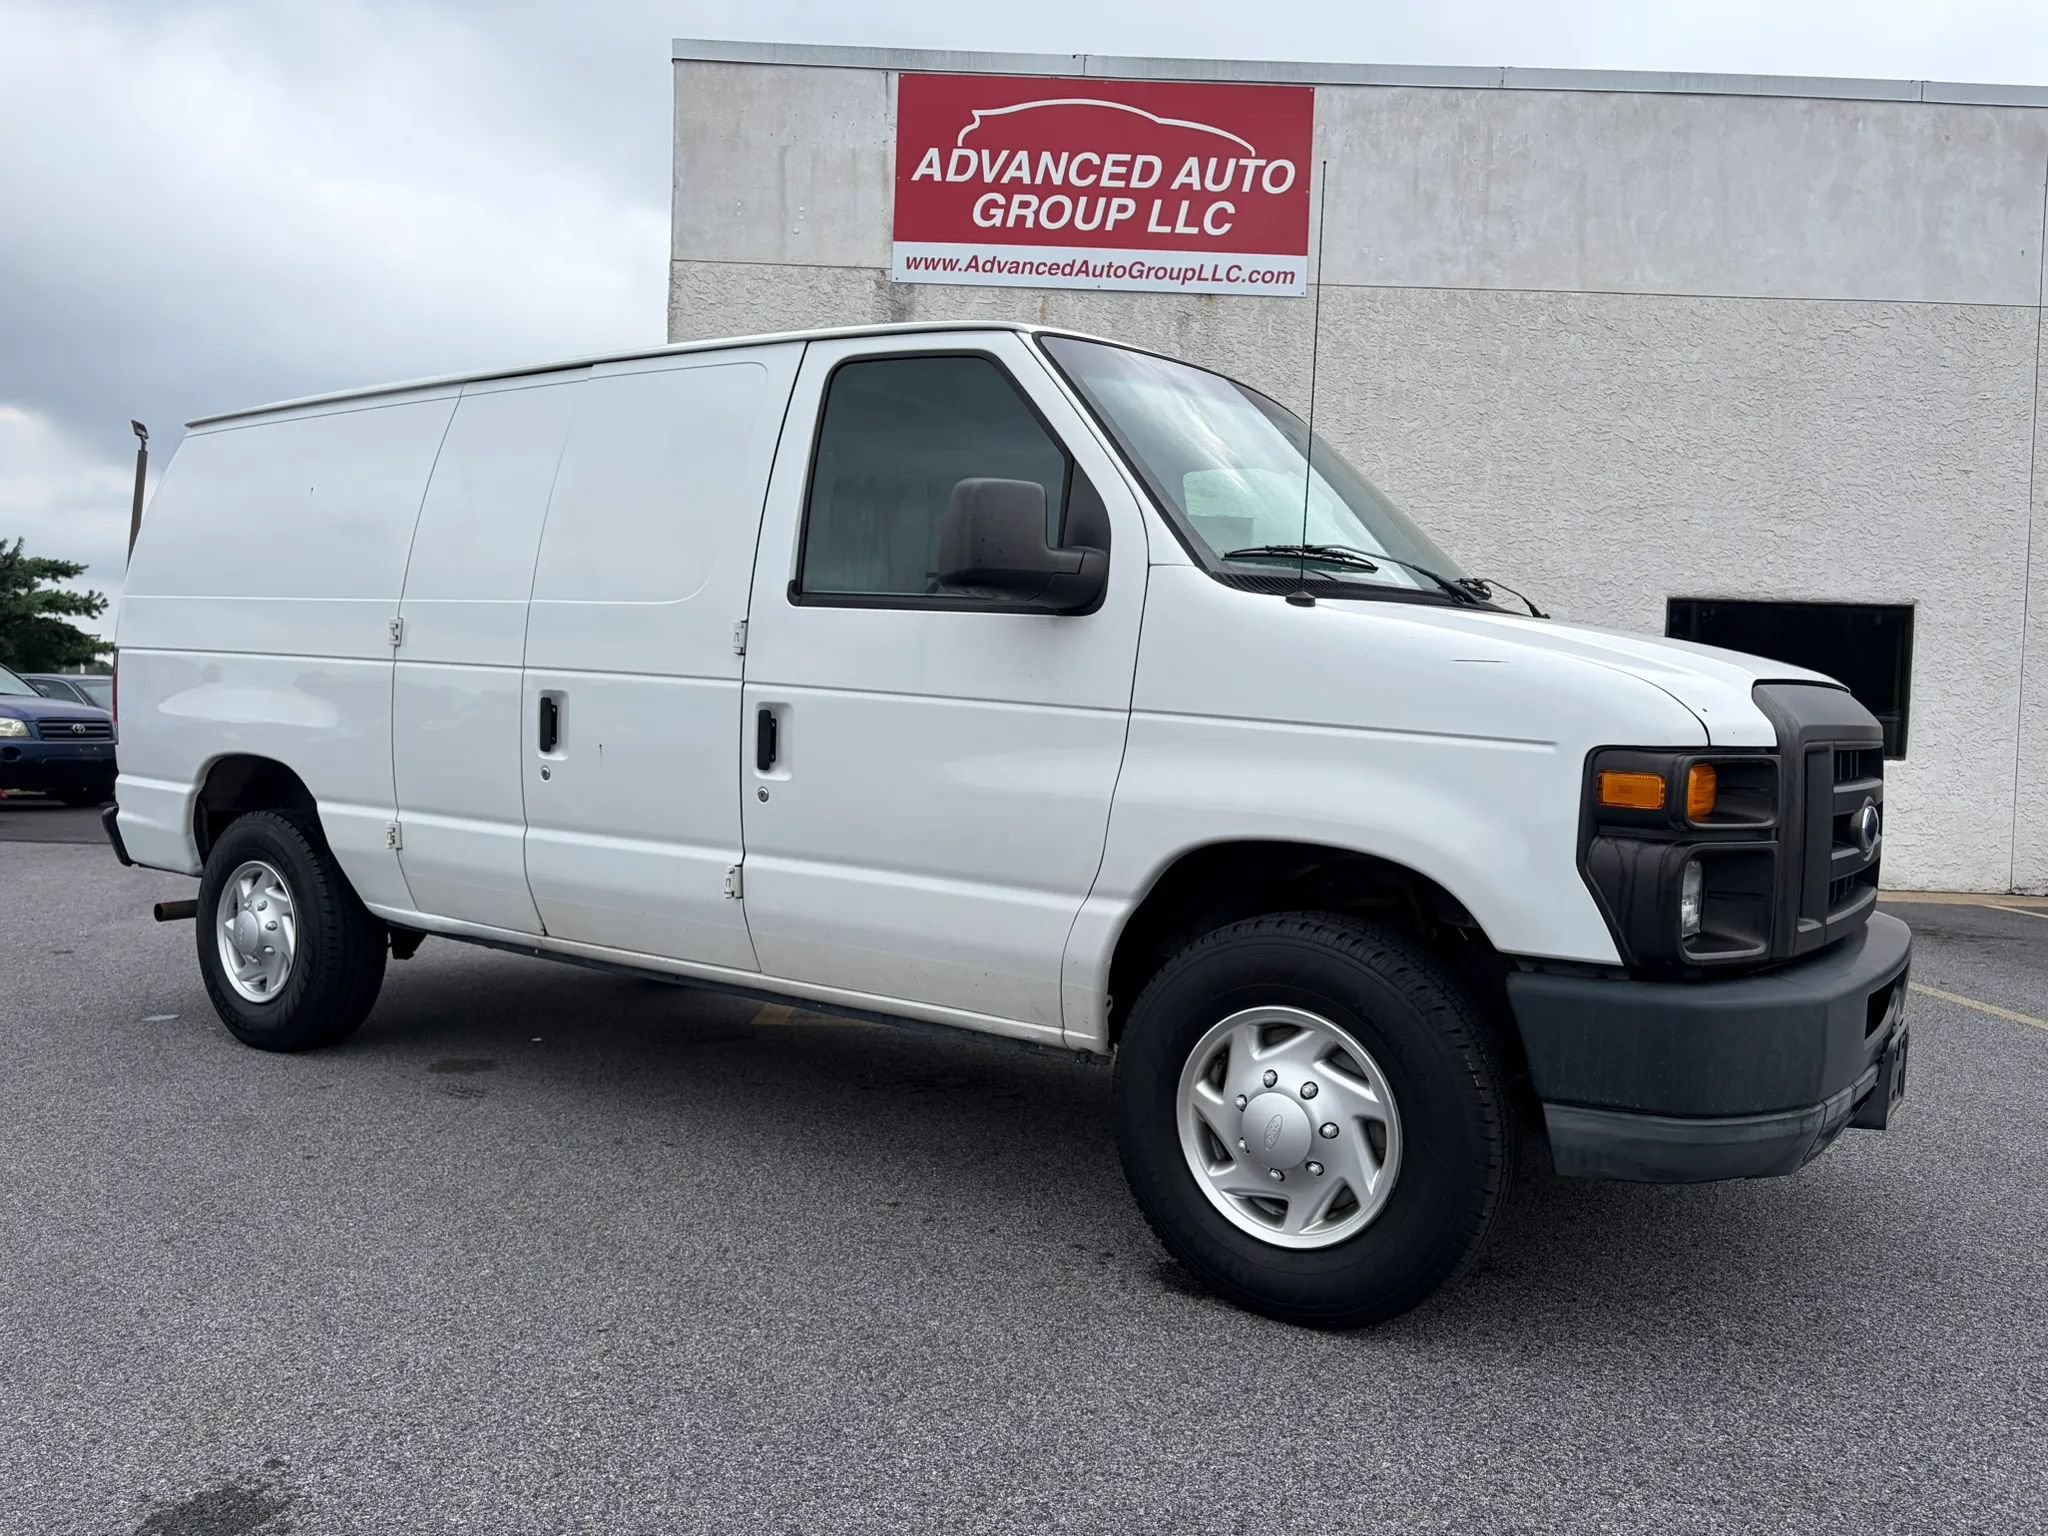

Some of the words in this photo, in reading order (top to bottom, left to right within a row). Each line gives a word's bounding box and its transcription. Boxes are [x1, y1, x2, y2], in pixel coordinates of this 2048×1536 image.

[911, 148, 1163, 188] ADVANCED
[1171, 156, 1296, 194] AUTO
[972, 192, 1136, 231] GROUP
[1147, 200, 1236, 236] LLC
[905, 255, 1296, 286] www.AdvancedAutoGroupLLC.com
